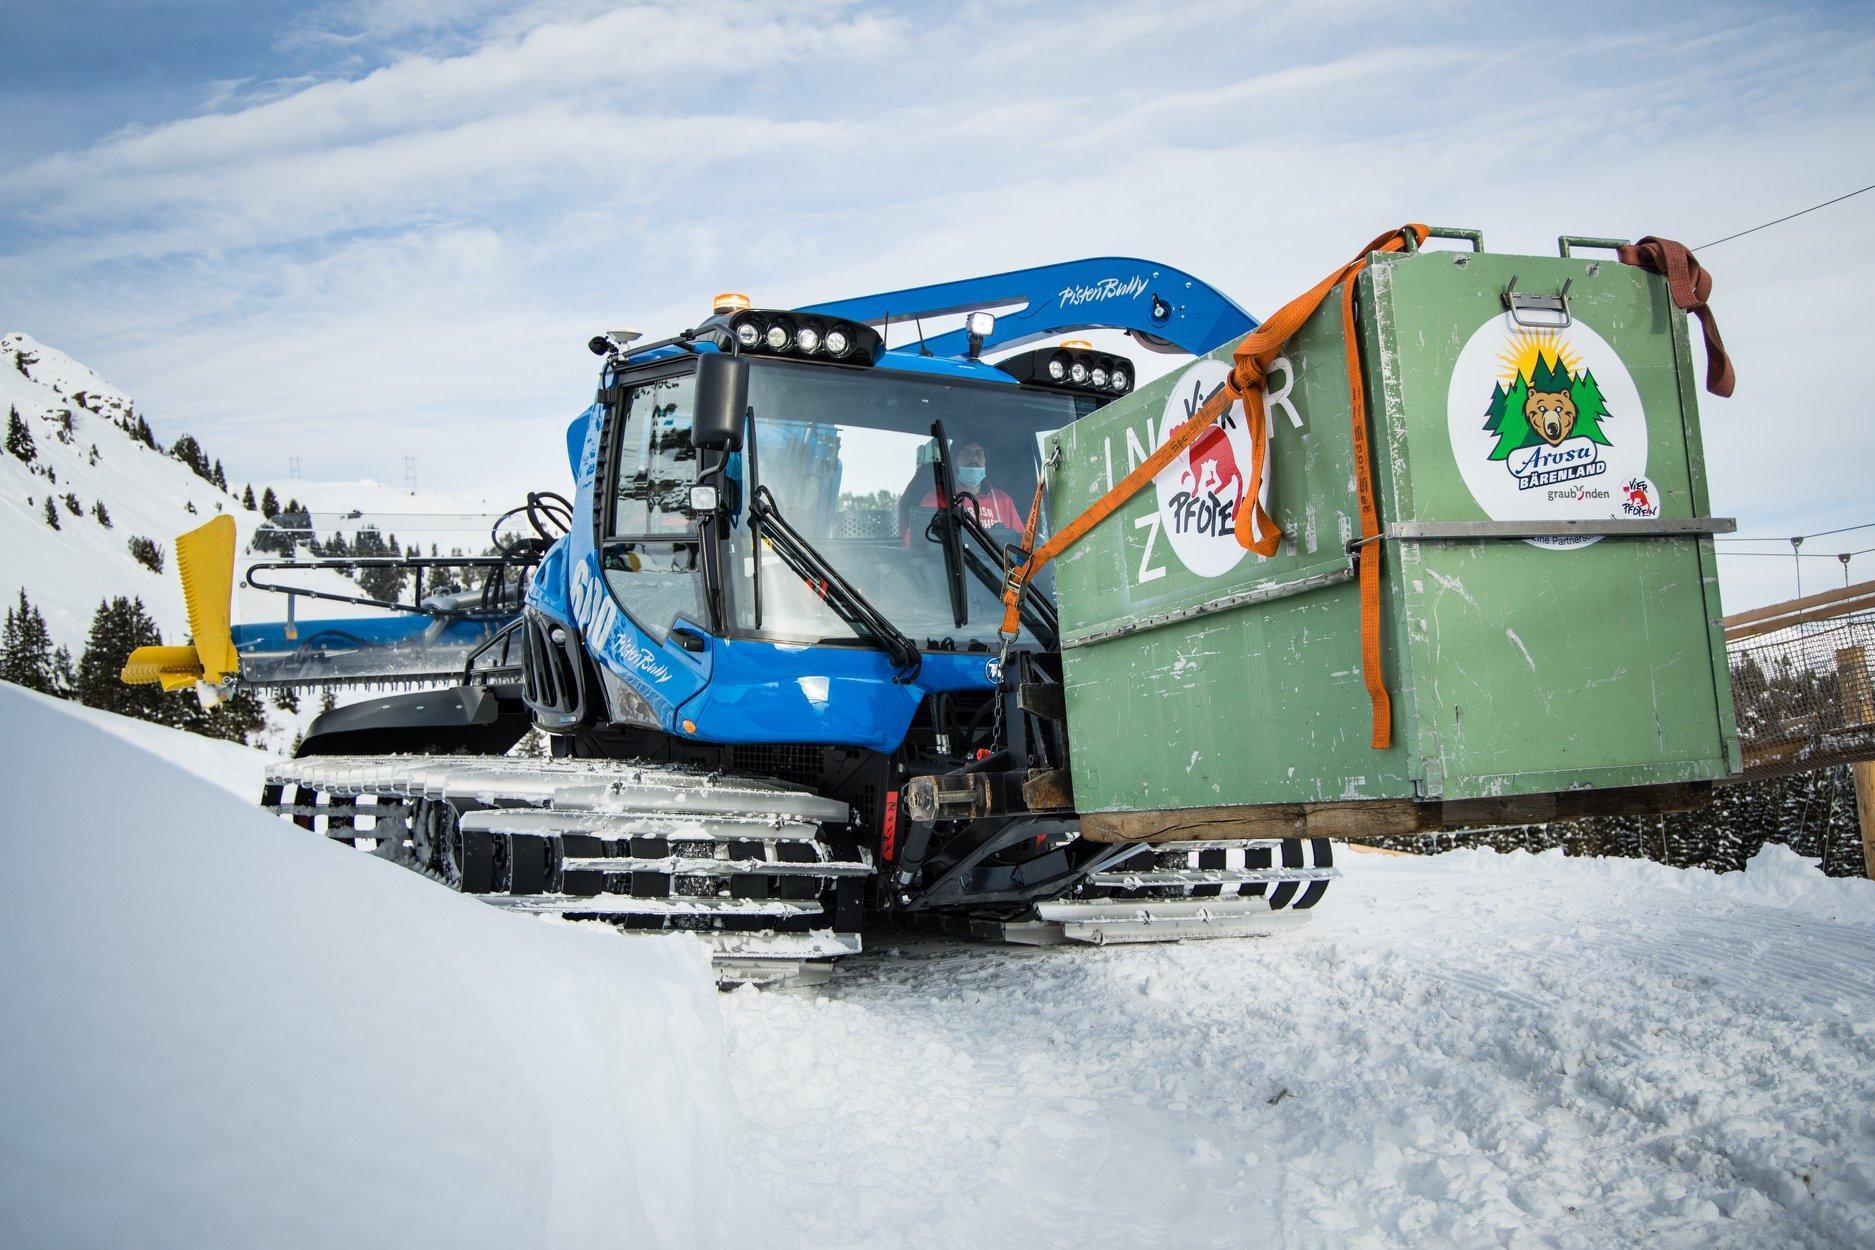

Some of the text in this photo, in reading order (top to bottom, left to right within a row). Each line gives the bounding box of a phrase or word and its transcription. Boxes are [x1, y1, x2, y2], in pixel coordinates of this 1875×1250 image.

[1059, 275, 1149, 308] PistenBully
[1515, 446, 1592, 474] Arosa
[1519, 462, 1605, 489] BÄRENLAND
[1169, 491, 1247, 537] PFOTE
[611, 631, 673, 684] PistenBully
